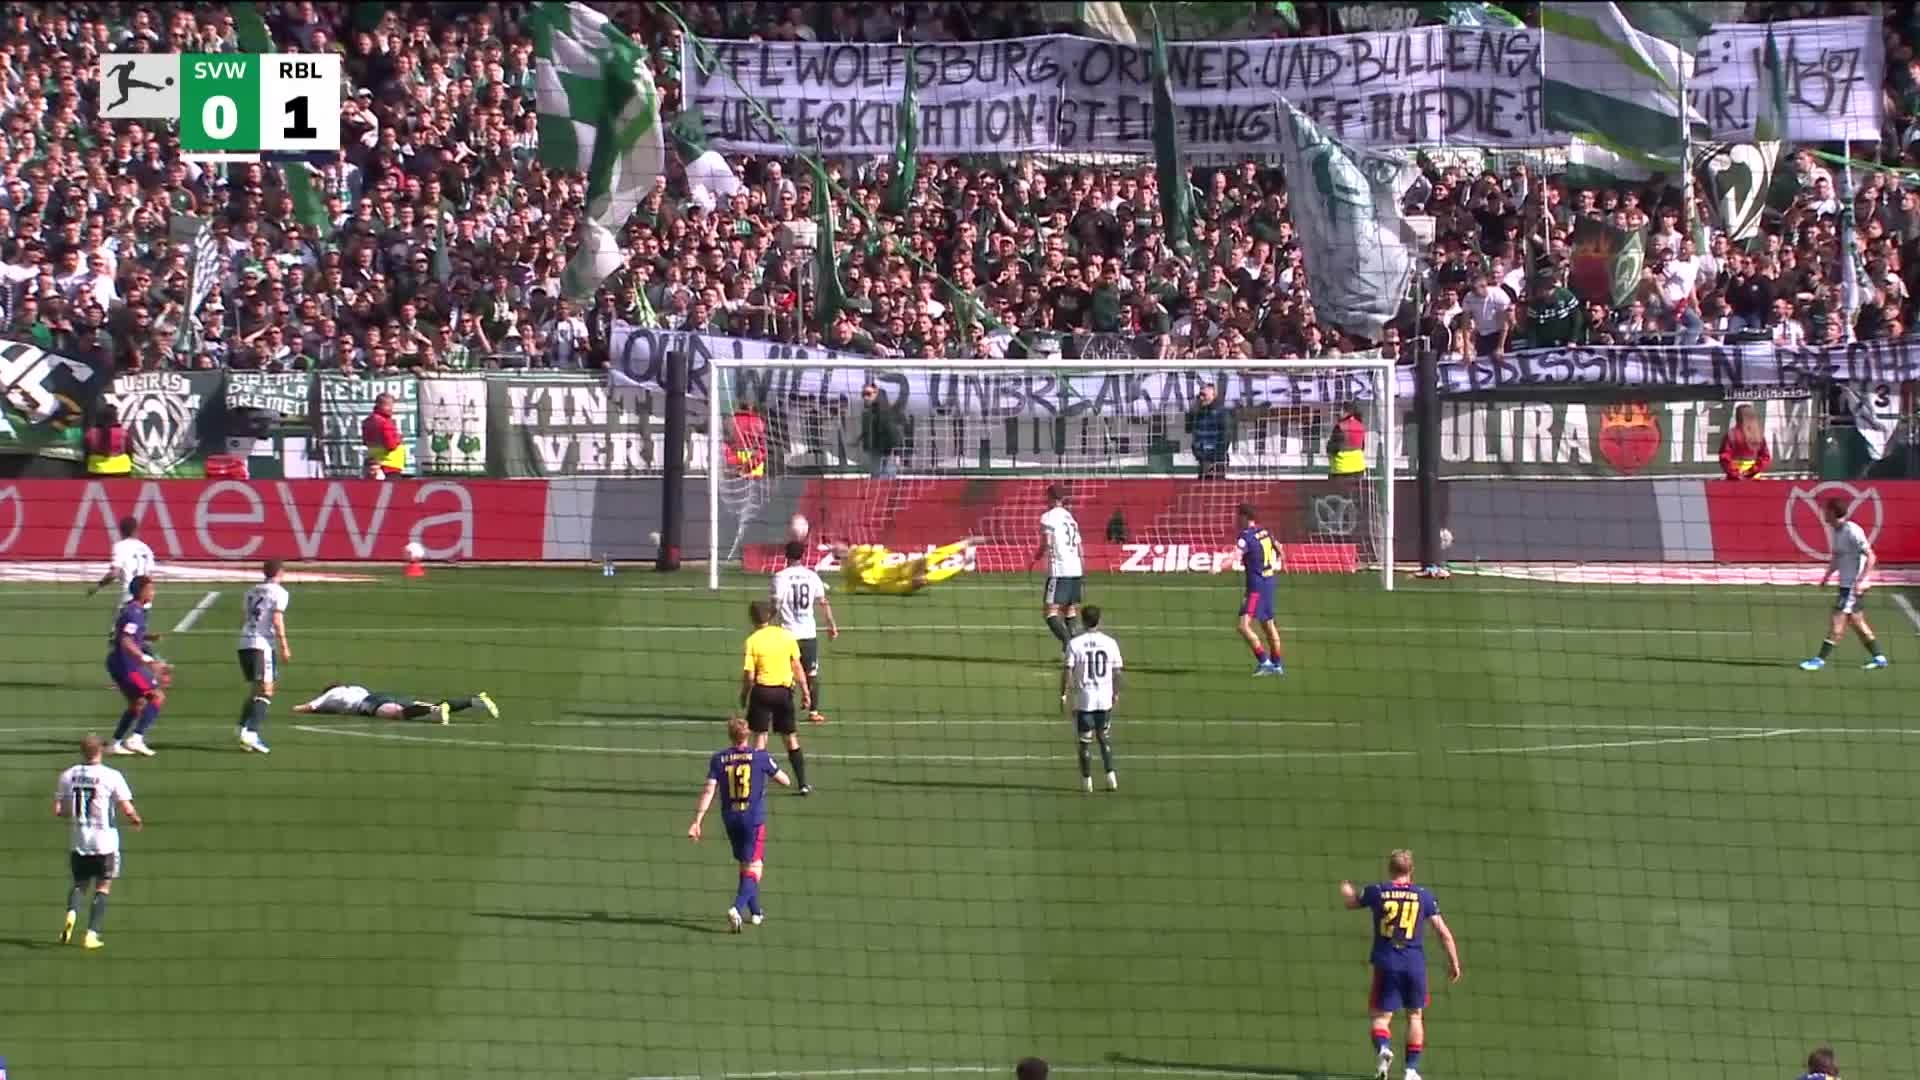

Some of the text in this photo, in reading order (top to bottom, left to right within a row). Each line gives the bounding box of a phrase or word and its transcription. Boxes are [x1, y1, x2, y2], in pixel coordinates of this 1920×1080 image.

[1262, 42, 1342, 89] UND
[797, 97, 1037, 147] ESKAATION
[1047, 95, 1105, 146] IST
[1369, 92, 1436, 143] AUF
[1443, 86, 1517, 138] DIE
[1440, 401, 1594, 465] ULTRA
[791, 582, 810, 611] 18
[1085, 649, 1108, 681] 10
[724, 763, 752, 799] 13
[72, 786, 97, 819] 17
[1380, 900, 1420, 940] 24
